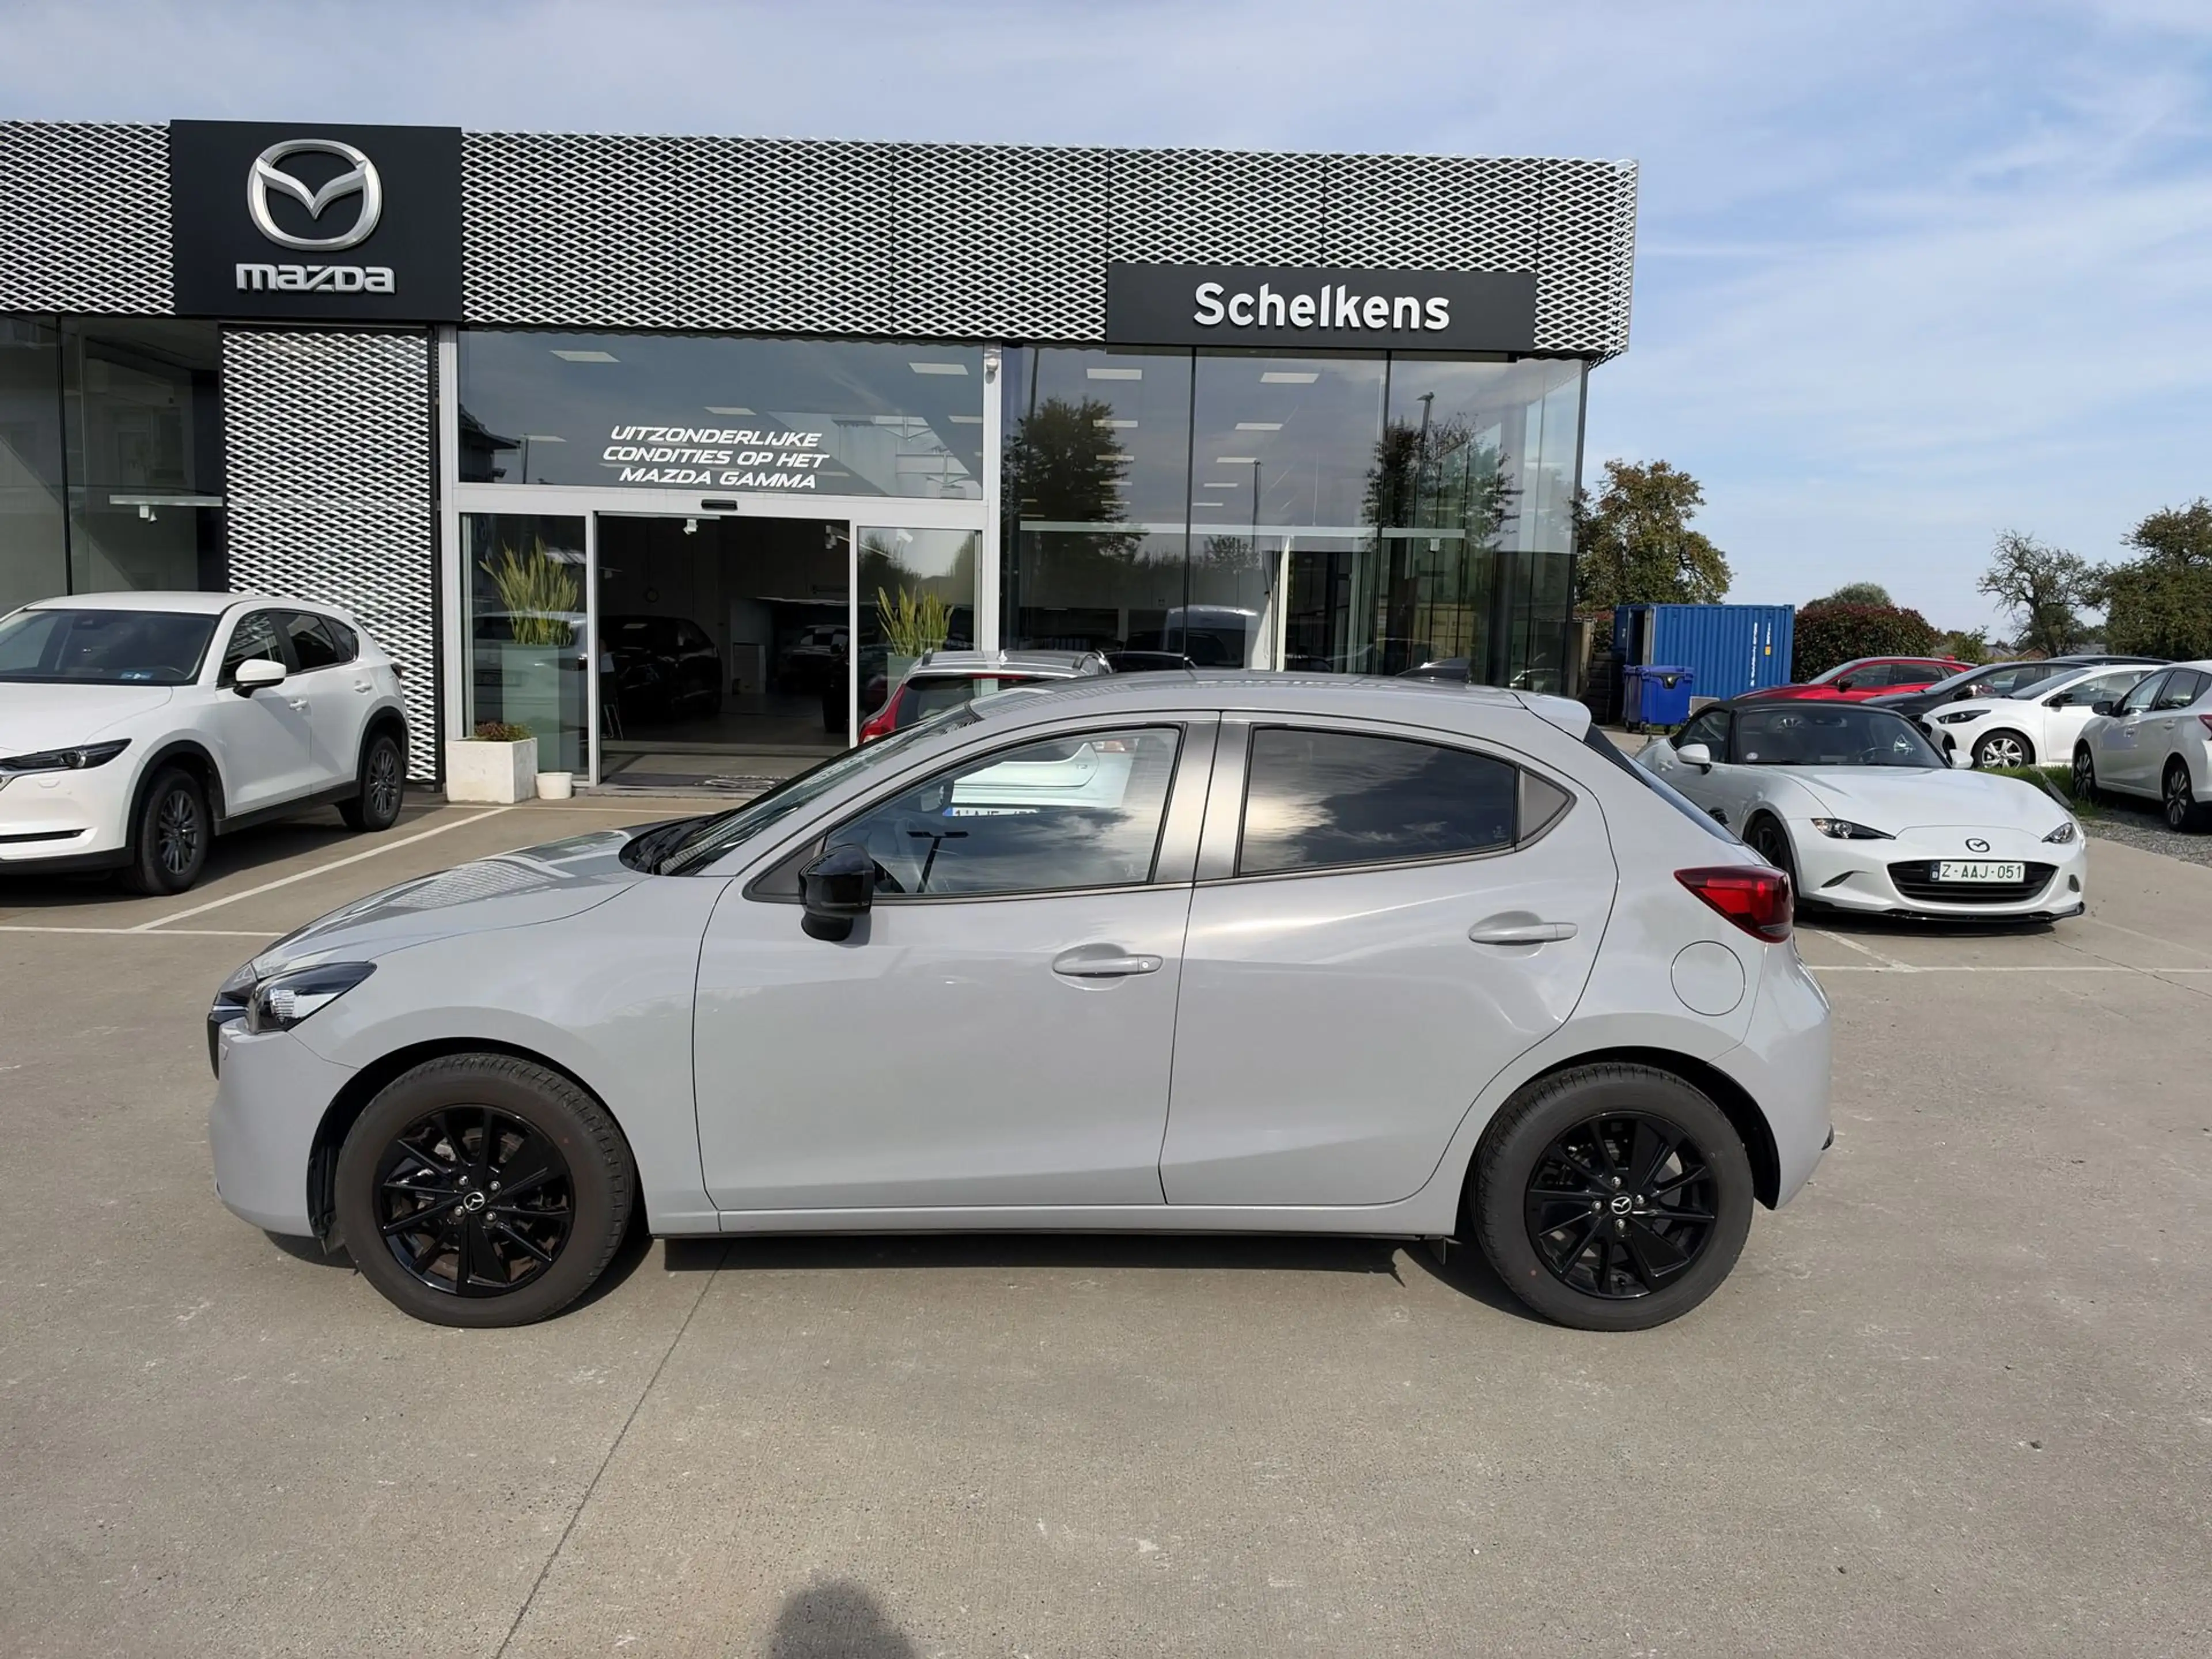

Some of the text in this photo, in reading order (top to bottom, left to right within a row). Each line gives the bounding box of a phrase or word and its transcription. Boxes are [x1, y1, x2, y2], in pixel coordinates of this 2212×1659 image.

[1193, 282, 1450, 330] Schelkens
[610, 425, 822, 448] UITZONDERLIJKE
[603, 446, 830, 468] CONDITIES OP HET
[619, 468, 816, 489] MAZDA GAMMA
